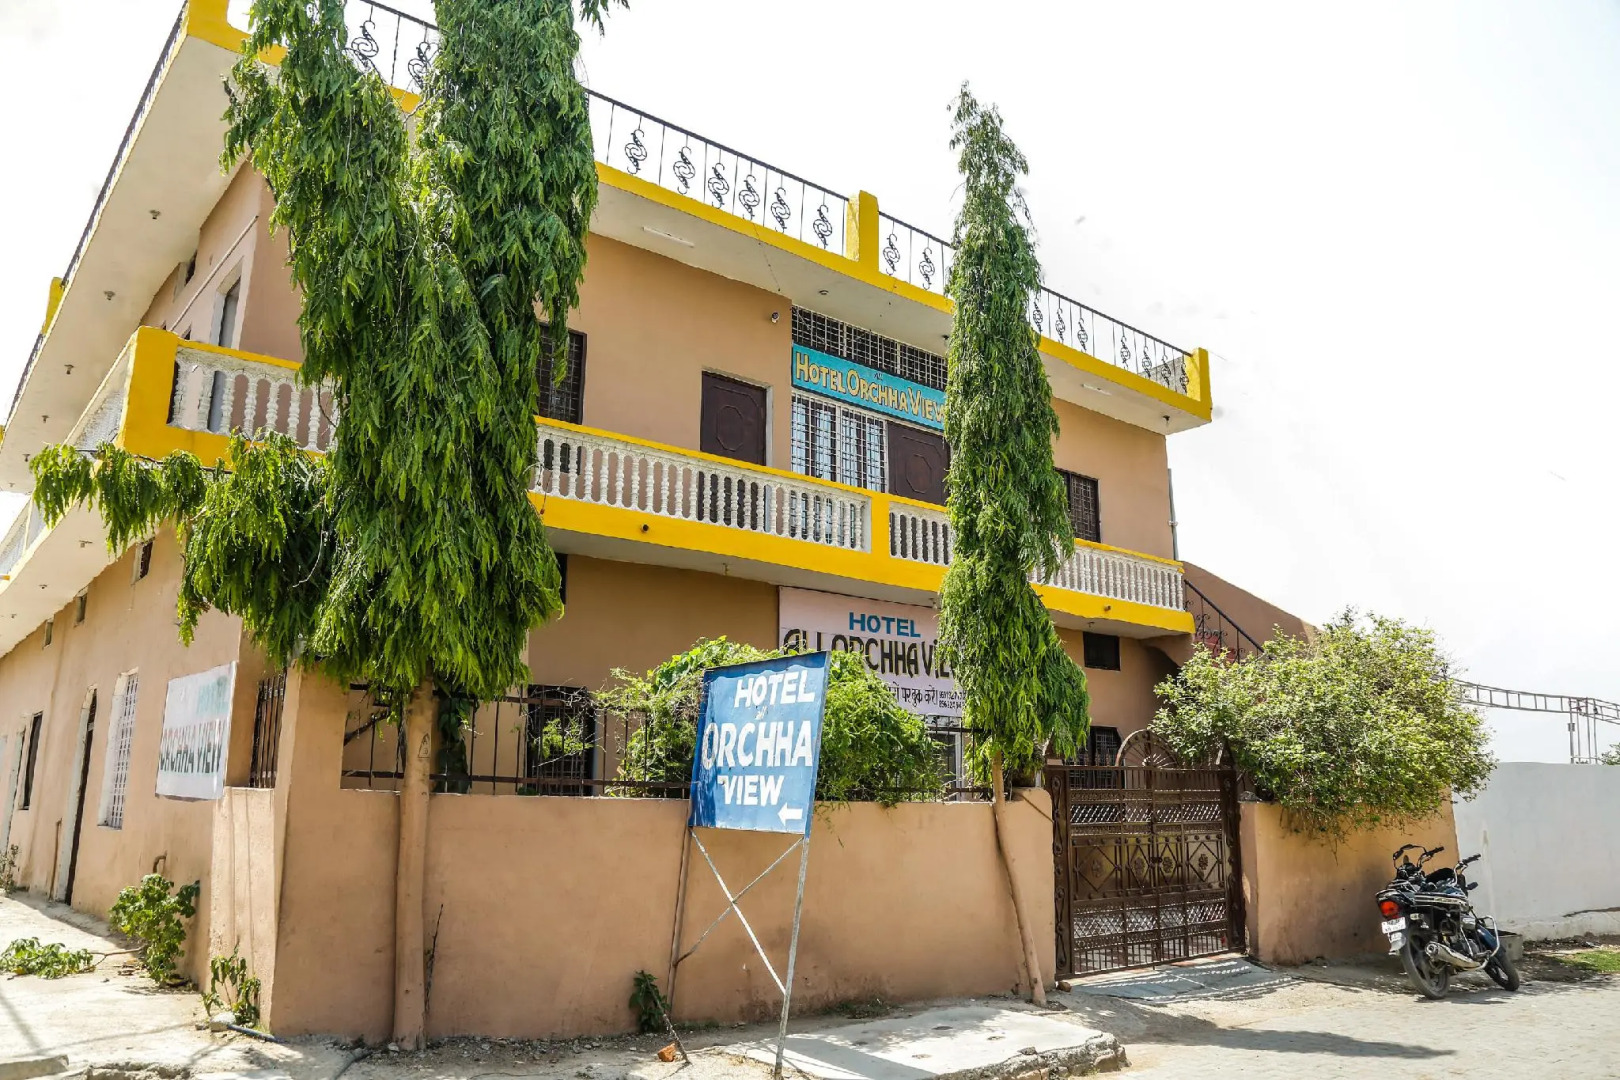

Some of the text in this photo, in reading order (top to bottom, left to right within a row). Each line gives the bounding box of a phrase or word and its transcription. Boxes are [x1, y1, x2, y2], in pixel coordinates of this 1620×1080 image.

[795, 351, 847, 394] HOTEL
[847, 368, 908, 414] ORCHHA
[849, 612, 921, 638] HOTEL
[734, 670, 815, 708] HOTEL
[701, 720, 813, 770] ORCHHA
[717, 775, 784, 806] VIEW
